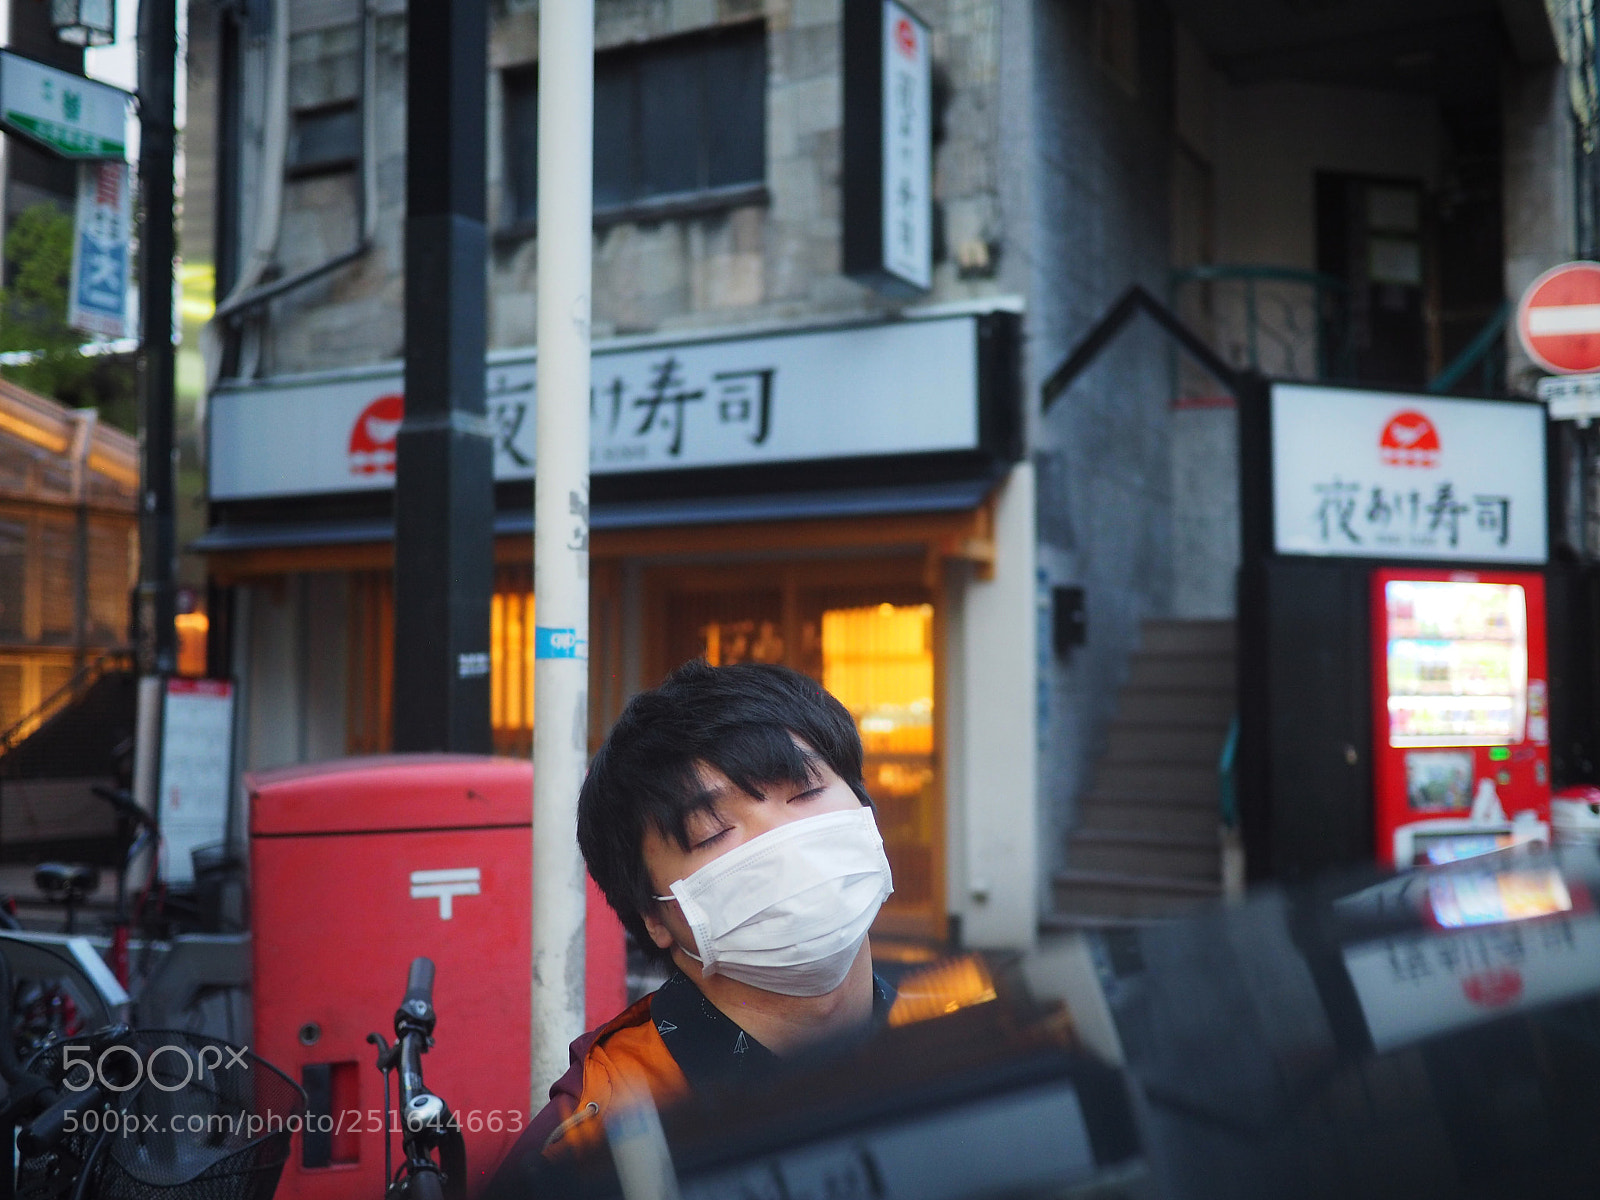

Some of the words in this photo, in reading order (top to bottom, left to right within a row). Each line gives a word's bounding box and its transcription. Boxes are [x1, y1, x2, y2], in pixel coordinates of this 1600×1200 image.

[1312, 475, 1511, 548] 夜あけ寿司
